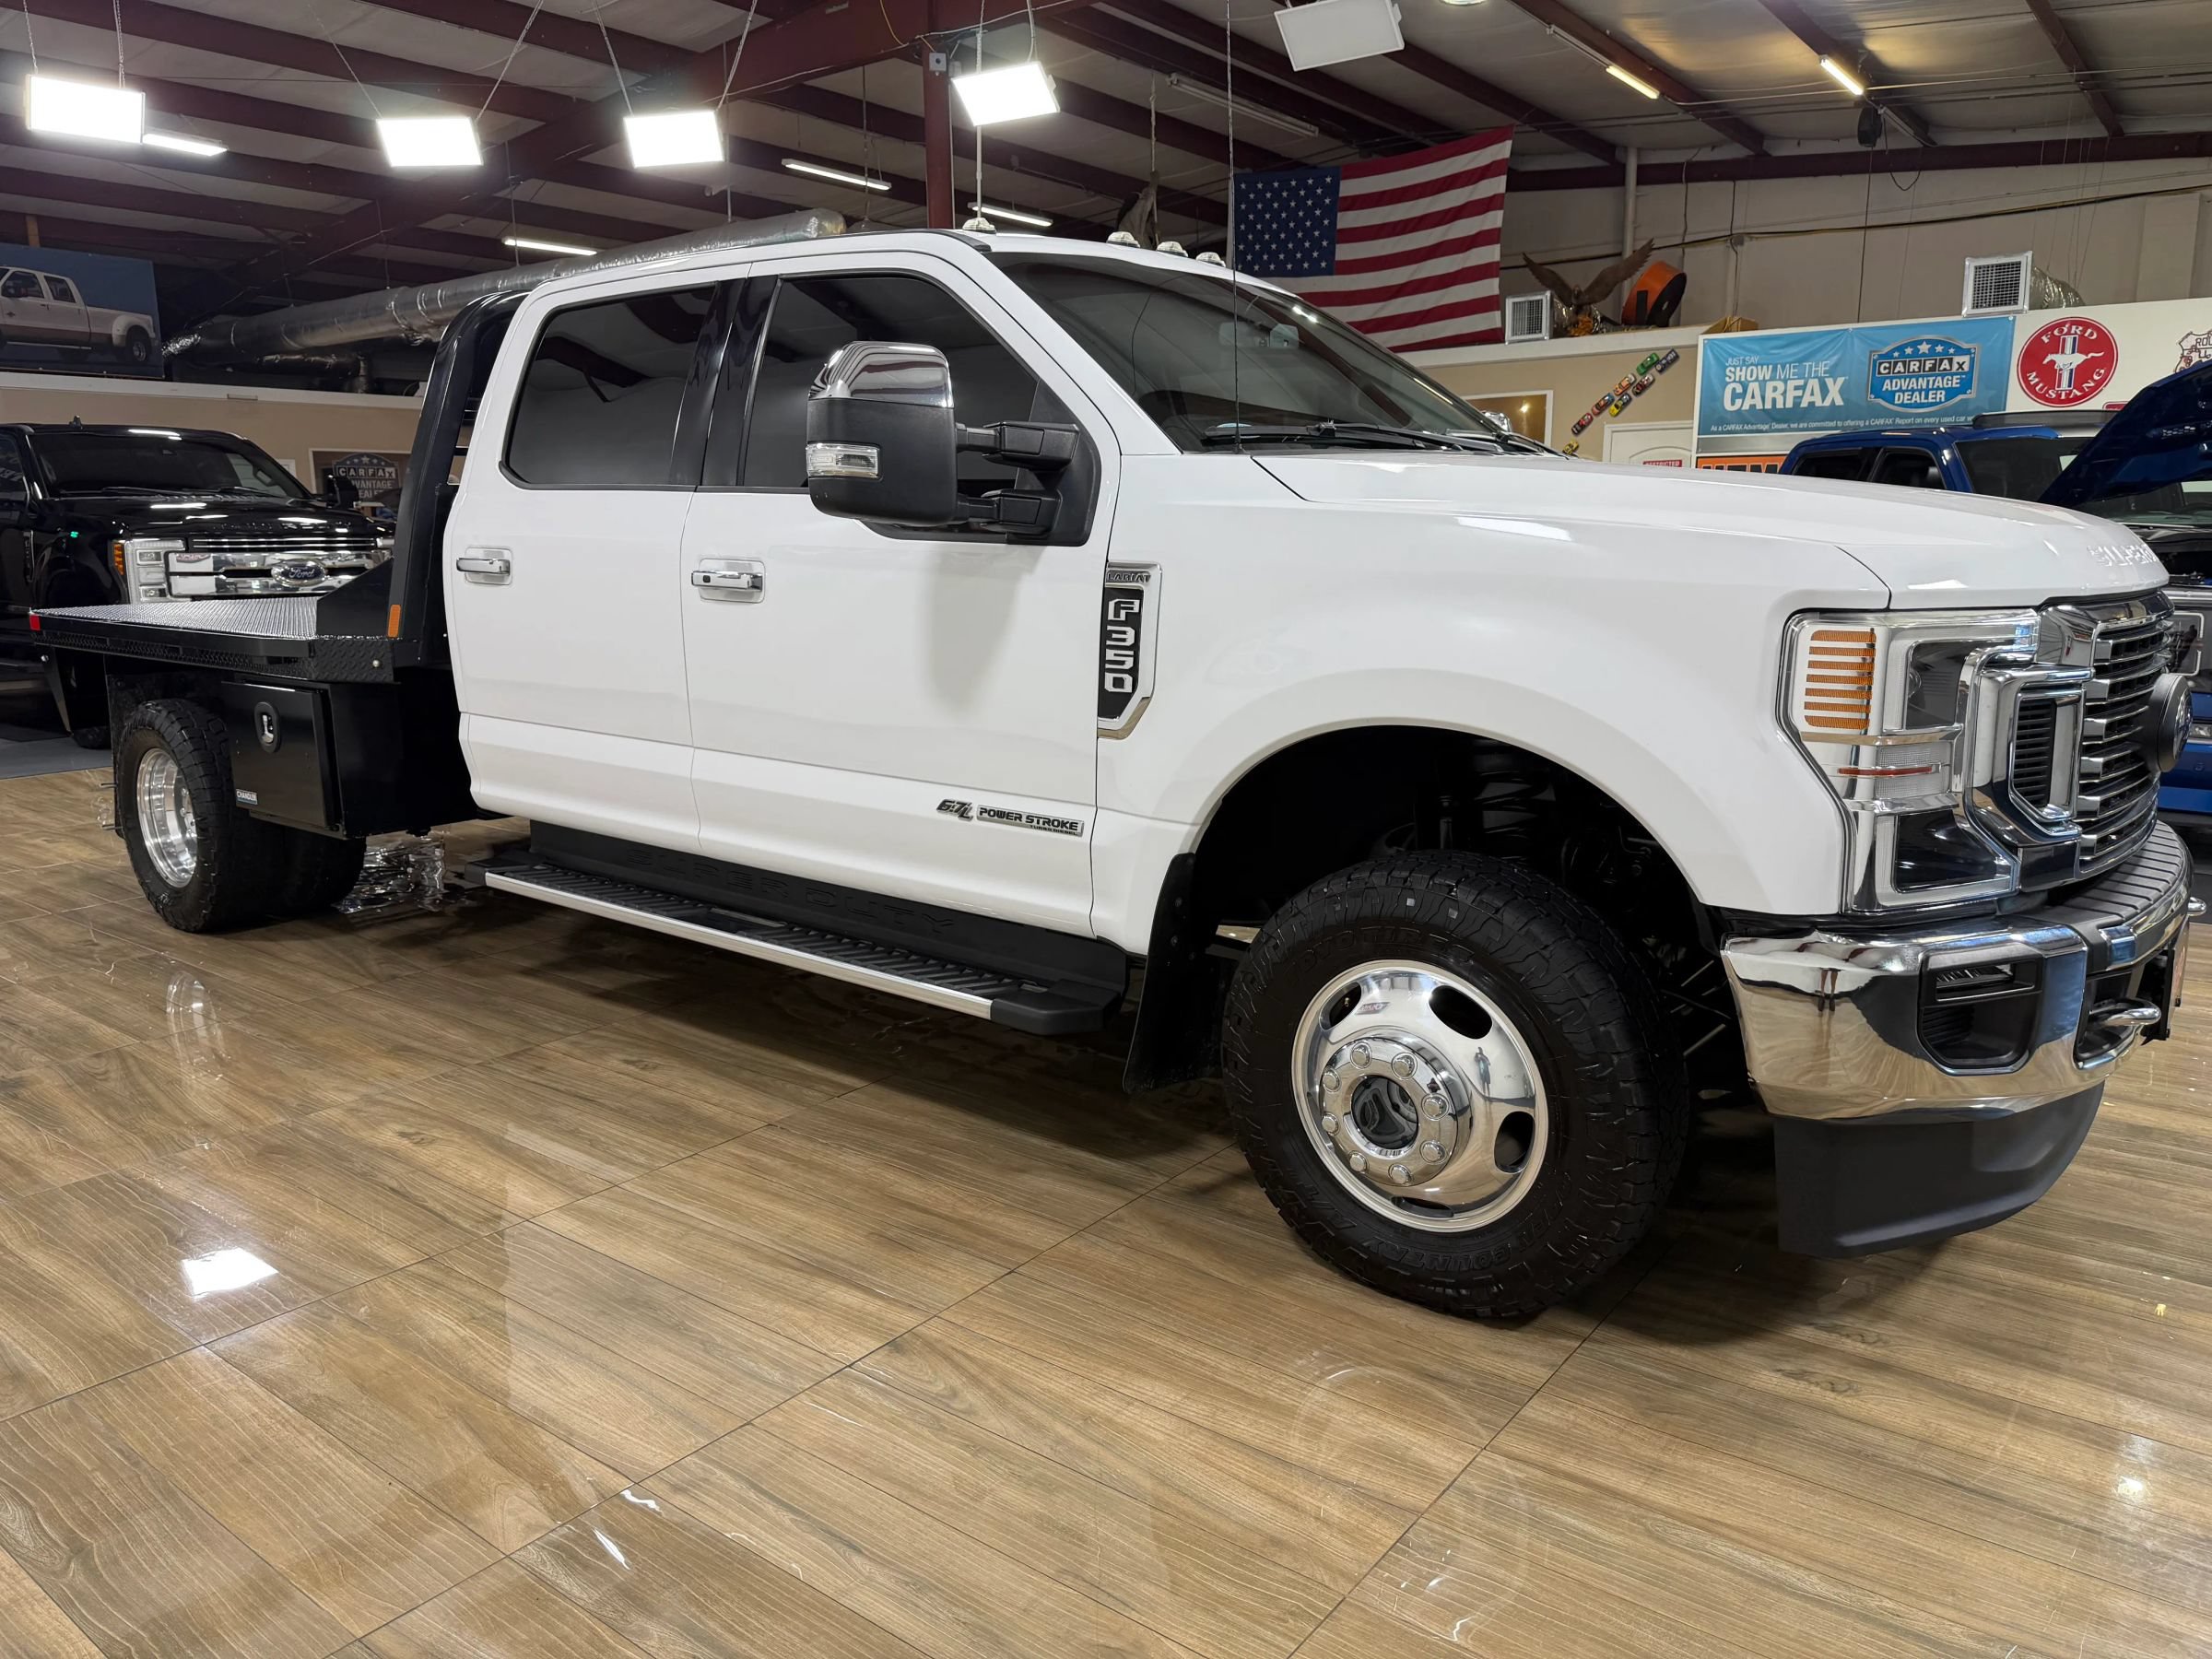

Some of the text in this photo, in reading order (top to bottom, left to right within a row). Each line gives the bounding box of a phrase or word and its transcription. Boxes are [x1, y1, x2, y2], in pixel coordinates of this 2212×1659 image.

[2041, 324, 2098, 344] FORD
[1725, 355, 1759, 366] JUST SAY
[1878, 358, 1968, 374] CARFAX
[1724, 360, 1830, 382] SHOW ME THE
[2027, 368, 2106, 400] MUSTANG
[1723, 376, 1845, 412] CARFAX
[1894, 390, 1946, 405] DEALER
[1843, 419, 1865, 428] offering
[1895, 417, 1914, 425] Report
[1924, 417, 1939, 425] every
[338, 467, 395, 478] CARFAX
[288, 567, 314, 579] Ford
[1107, 571, 1151, 583] LARIAT
[1104, 598, 1141, 693] F350
[979, 806, 1023, 823] POWER
[1025, 815, 1079, 831] STROKE
[1359, 1223, 1520, 1277] COUNTRY
